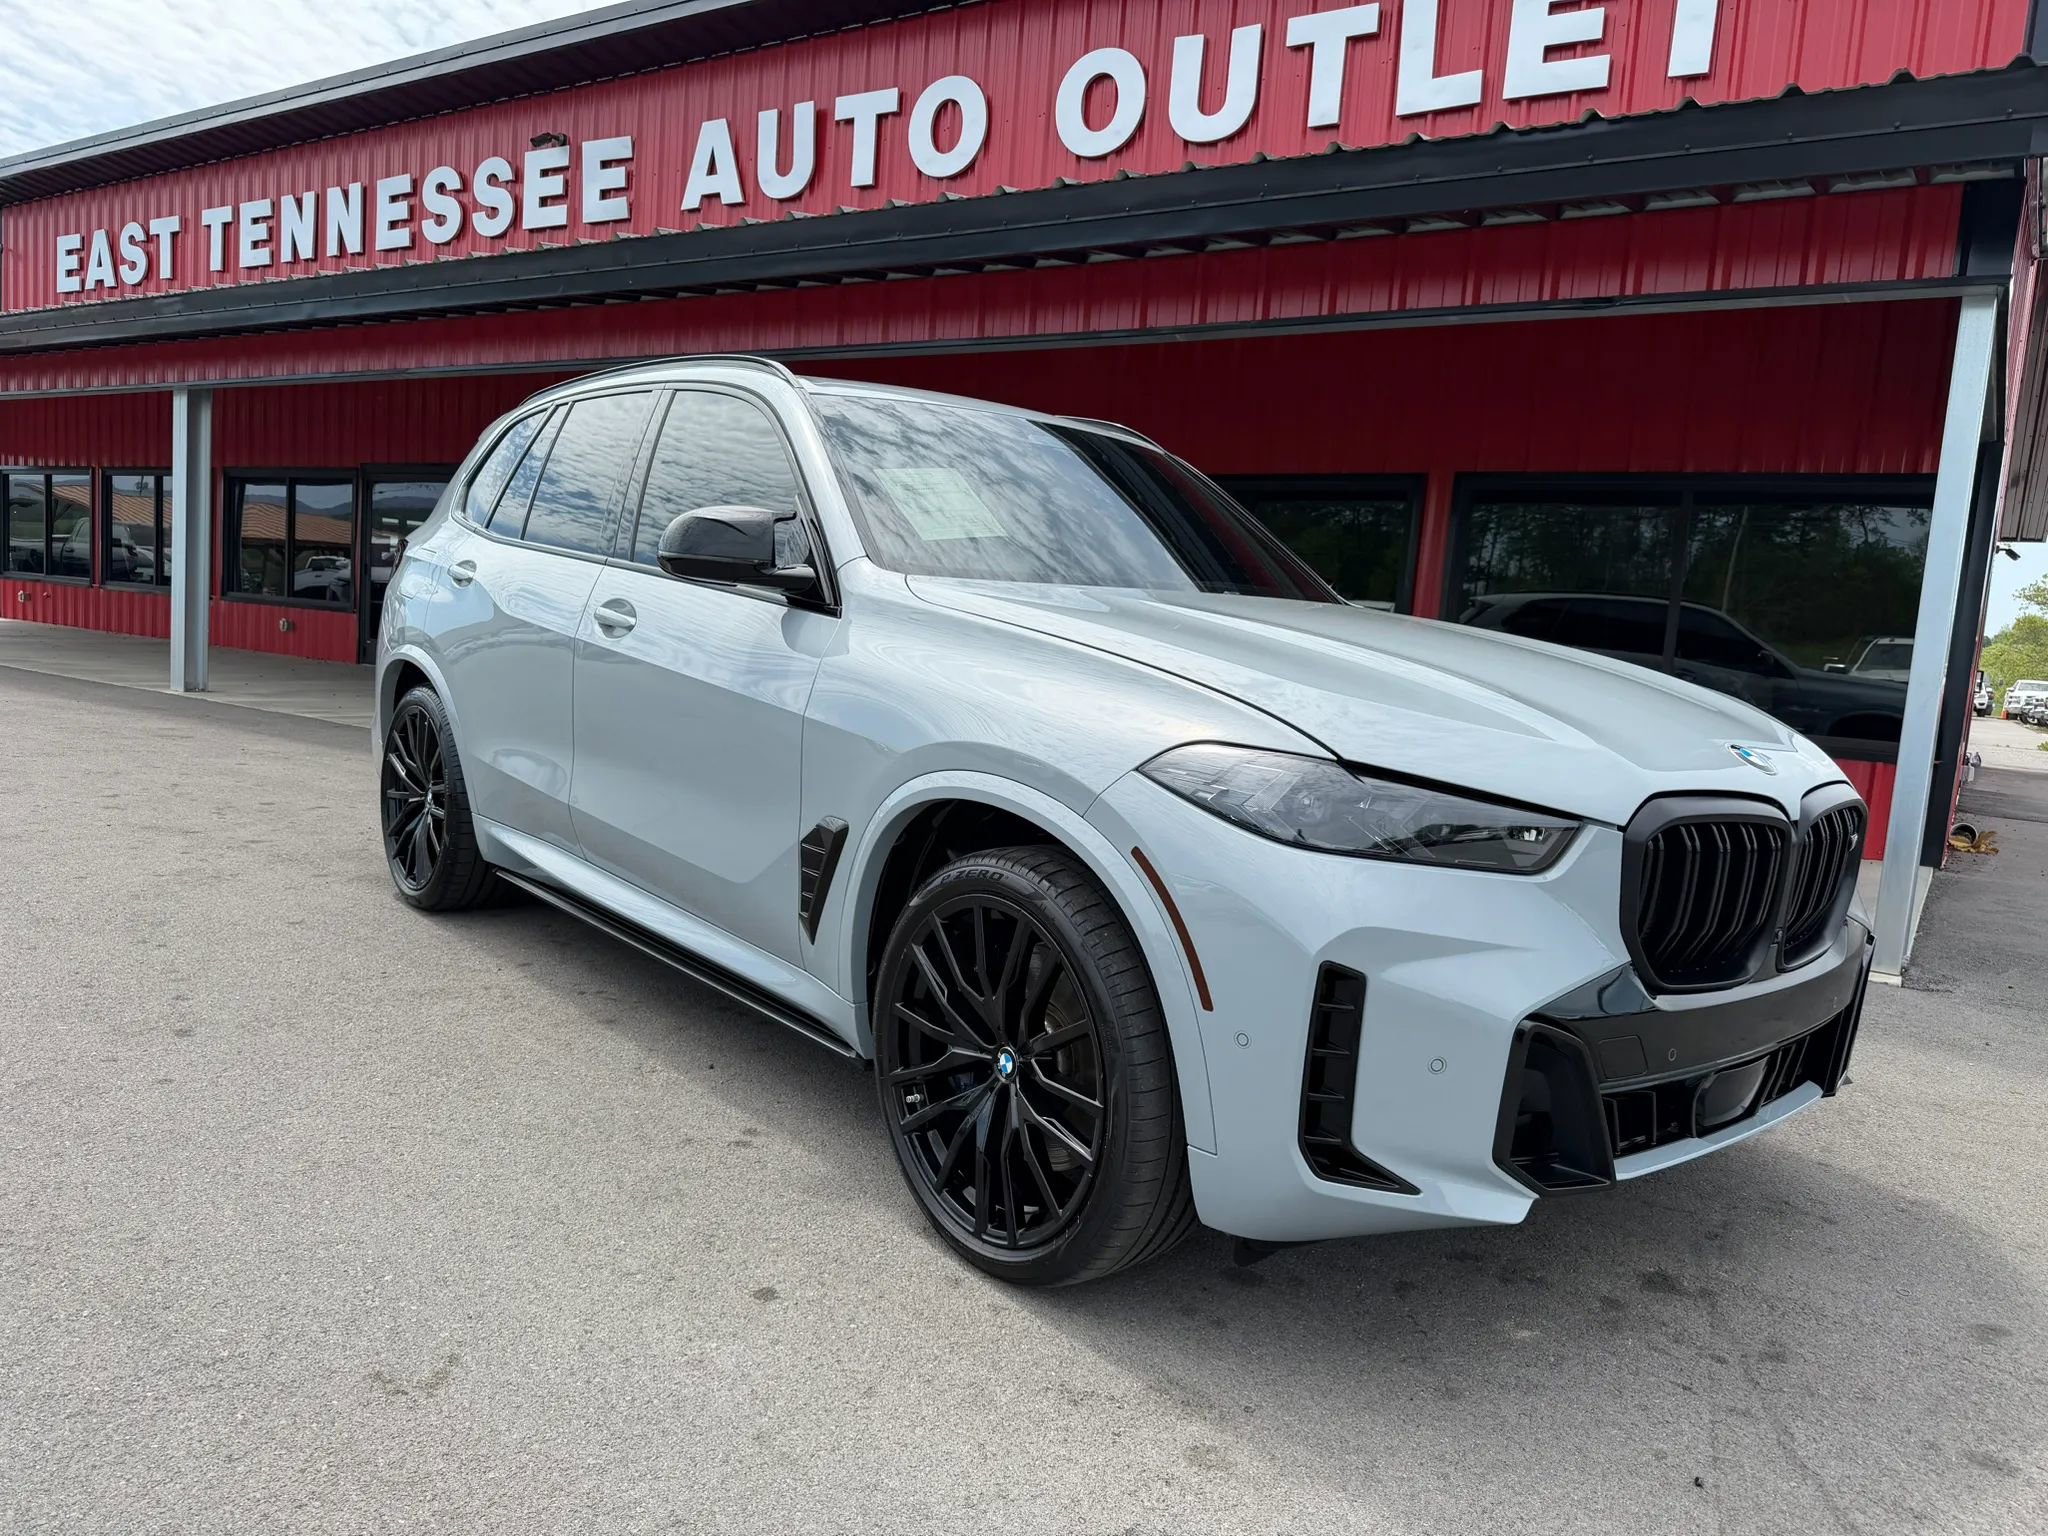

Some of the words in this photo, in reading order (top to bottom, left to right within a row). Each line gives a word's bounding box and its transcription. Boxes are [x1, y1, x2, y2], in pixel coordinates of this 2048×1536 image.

[56, 215, 181, 294] EAST
[201, 135, 634, 270] TENNESSEE
[680, 74, 989, 212] AUTO
[941, 873, 951, 885] P
[953, 868, 1005, 882] ZERO
